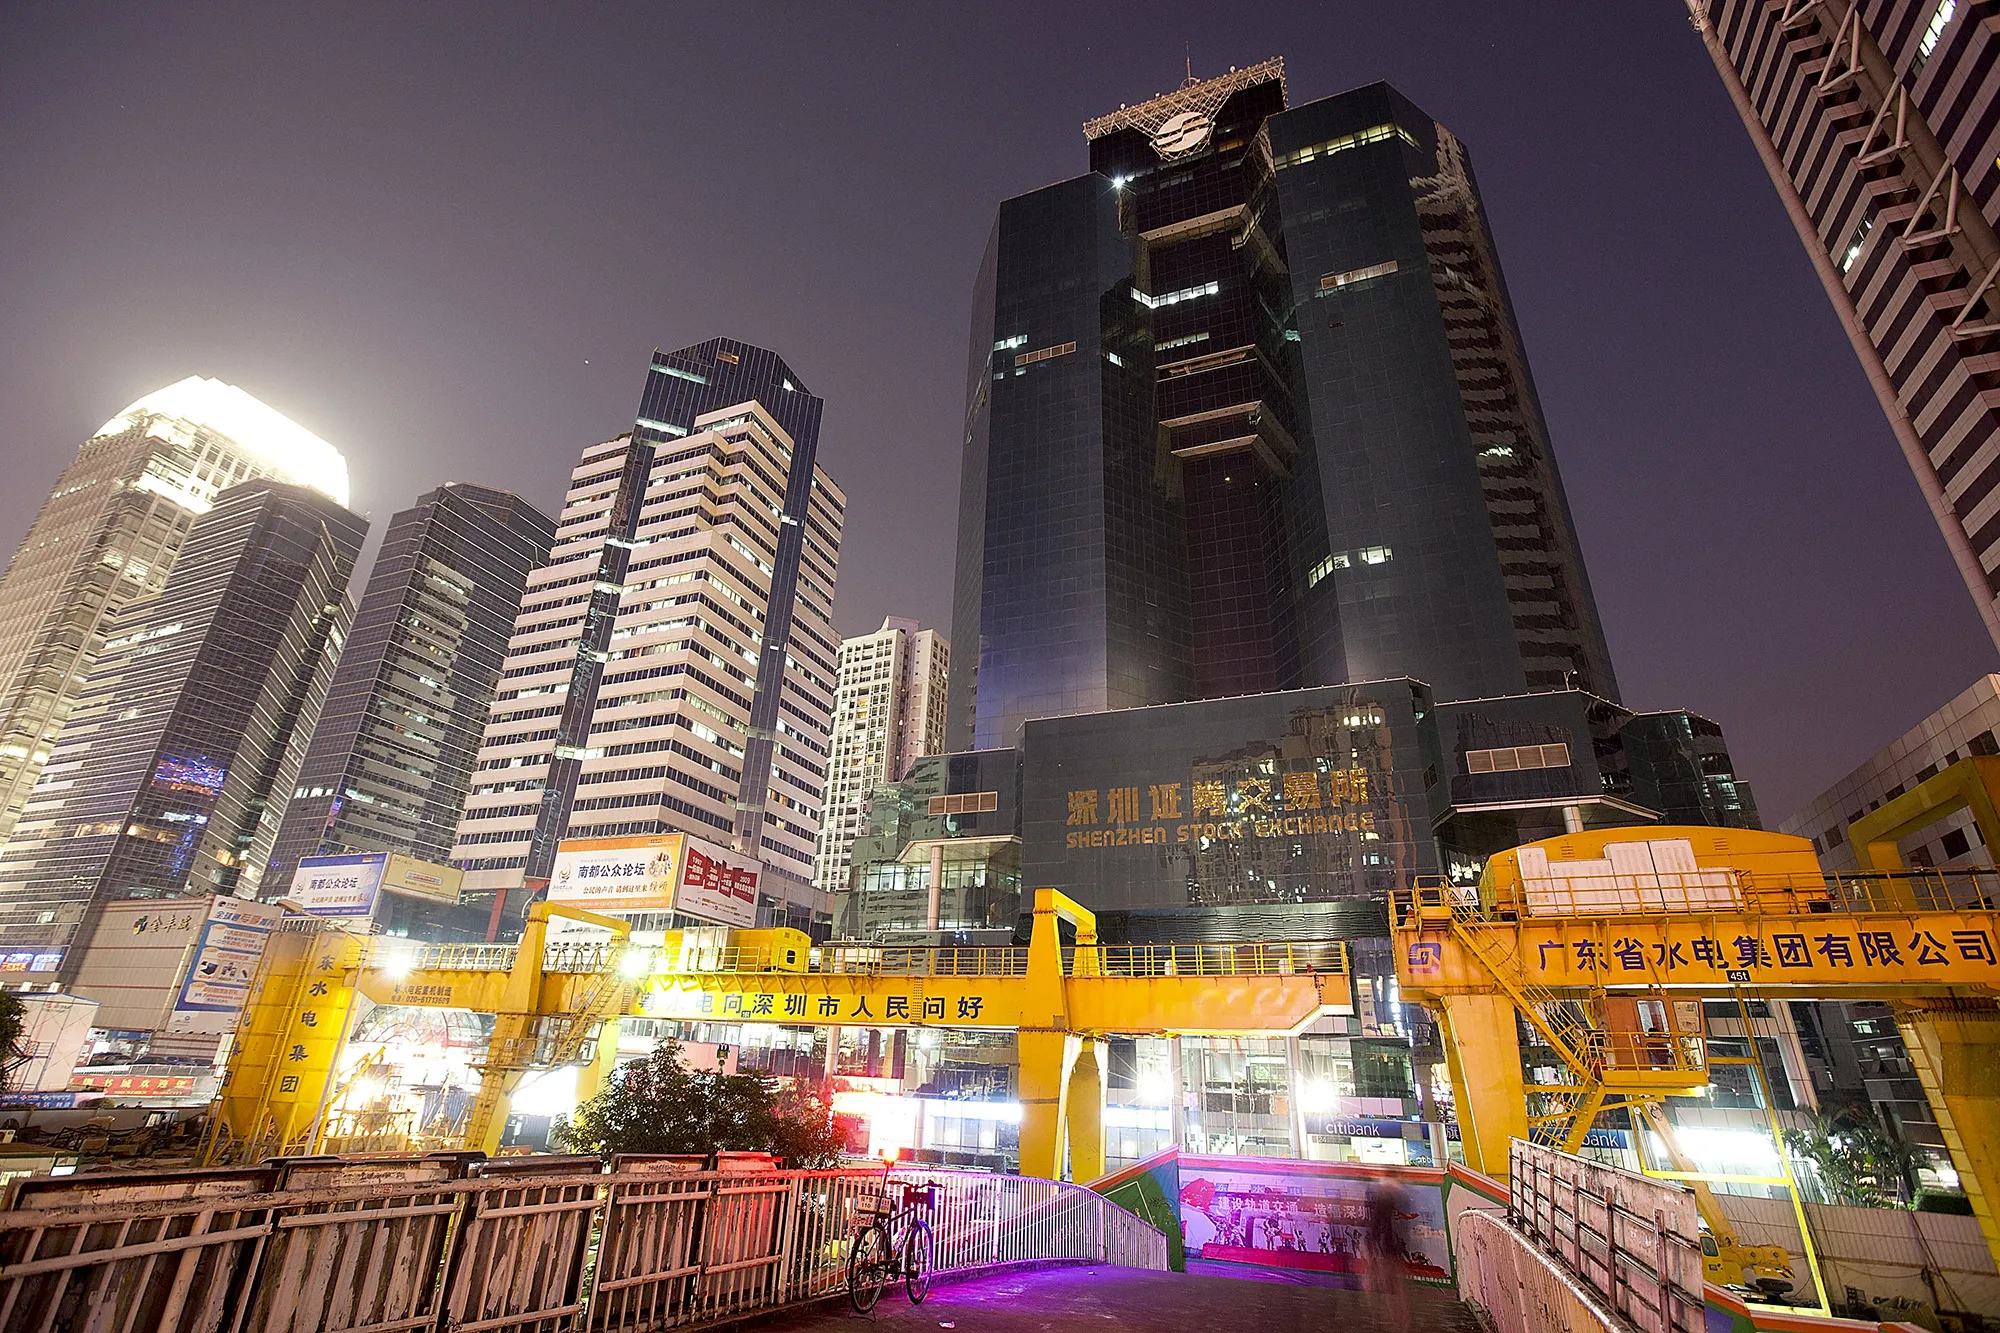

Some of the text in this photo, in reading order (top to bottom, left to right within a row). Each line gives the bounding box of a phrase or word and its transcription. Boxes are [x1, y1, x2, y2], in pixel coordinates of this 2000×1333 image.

[1066, 767, 1369, 826] 深圳证券交易所
[1066, 812, 1376, 849] SHENZHEN STOCK EXCHANGE
[578, 862, 645, 879] 南都公众论坛
[309, 877, 358, 890] 南都公众论坛
[1537, 930, 1999, 971] 广东省水电集团有限公司
[1730, 971, 1748, 980] 45t
[1326, 1122, 1380, 1136] citibank
[1217, 1194, 1373, 1221] 建设轨道交通 造福深圳
